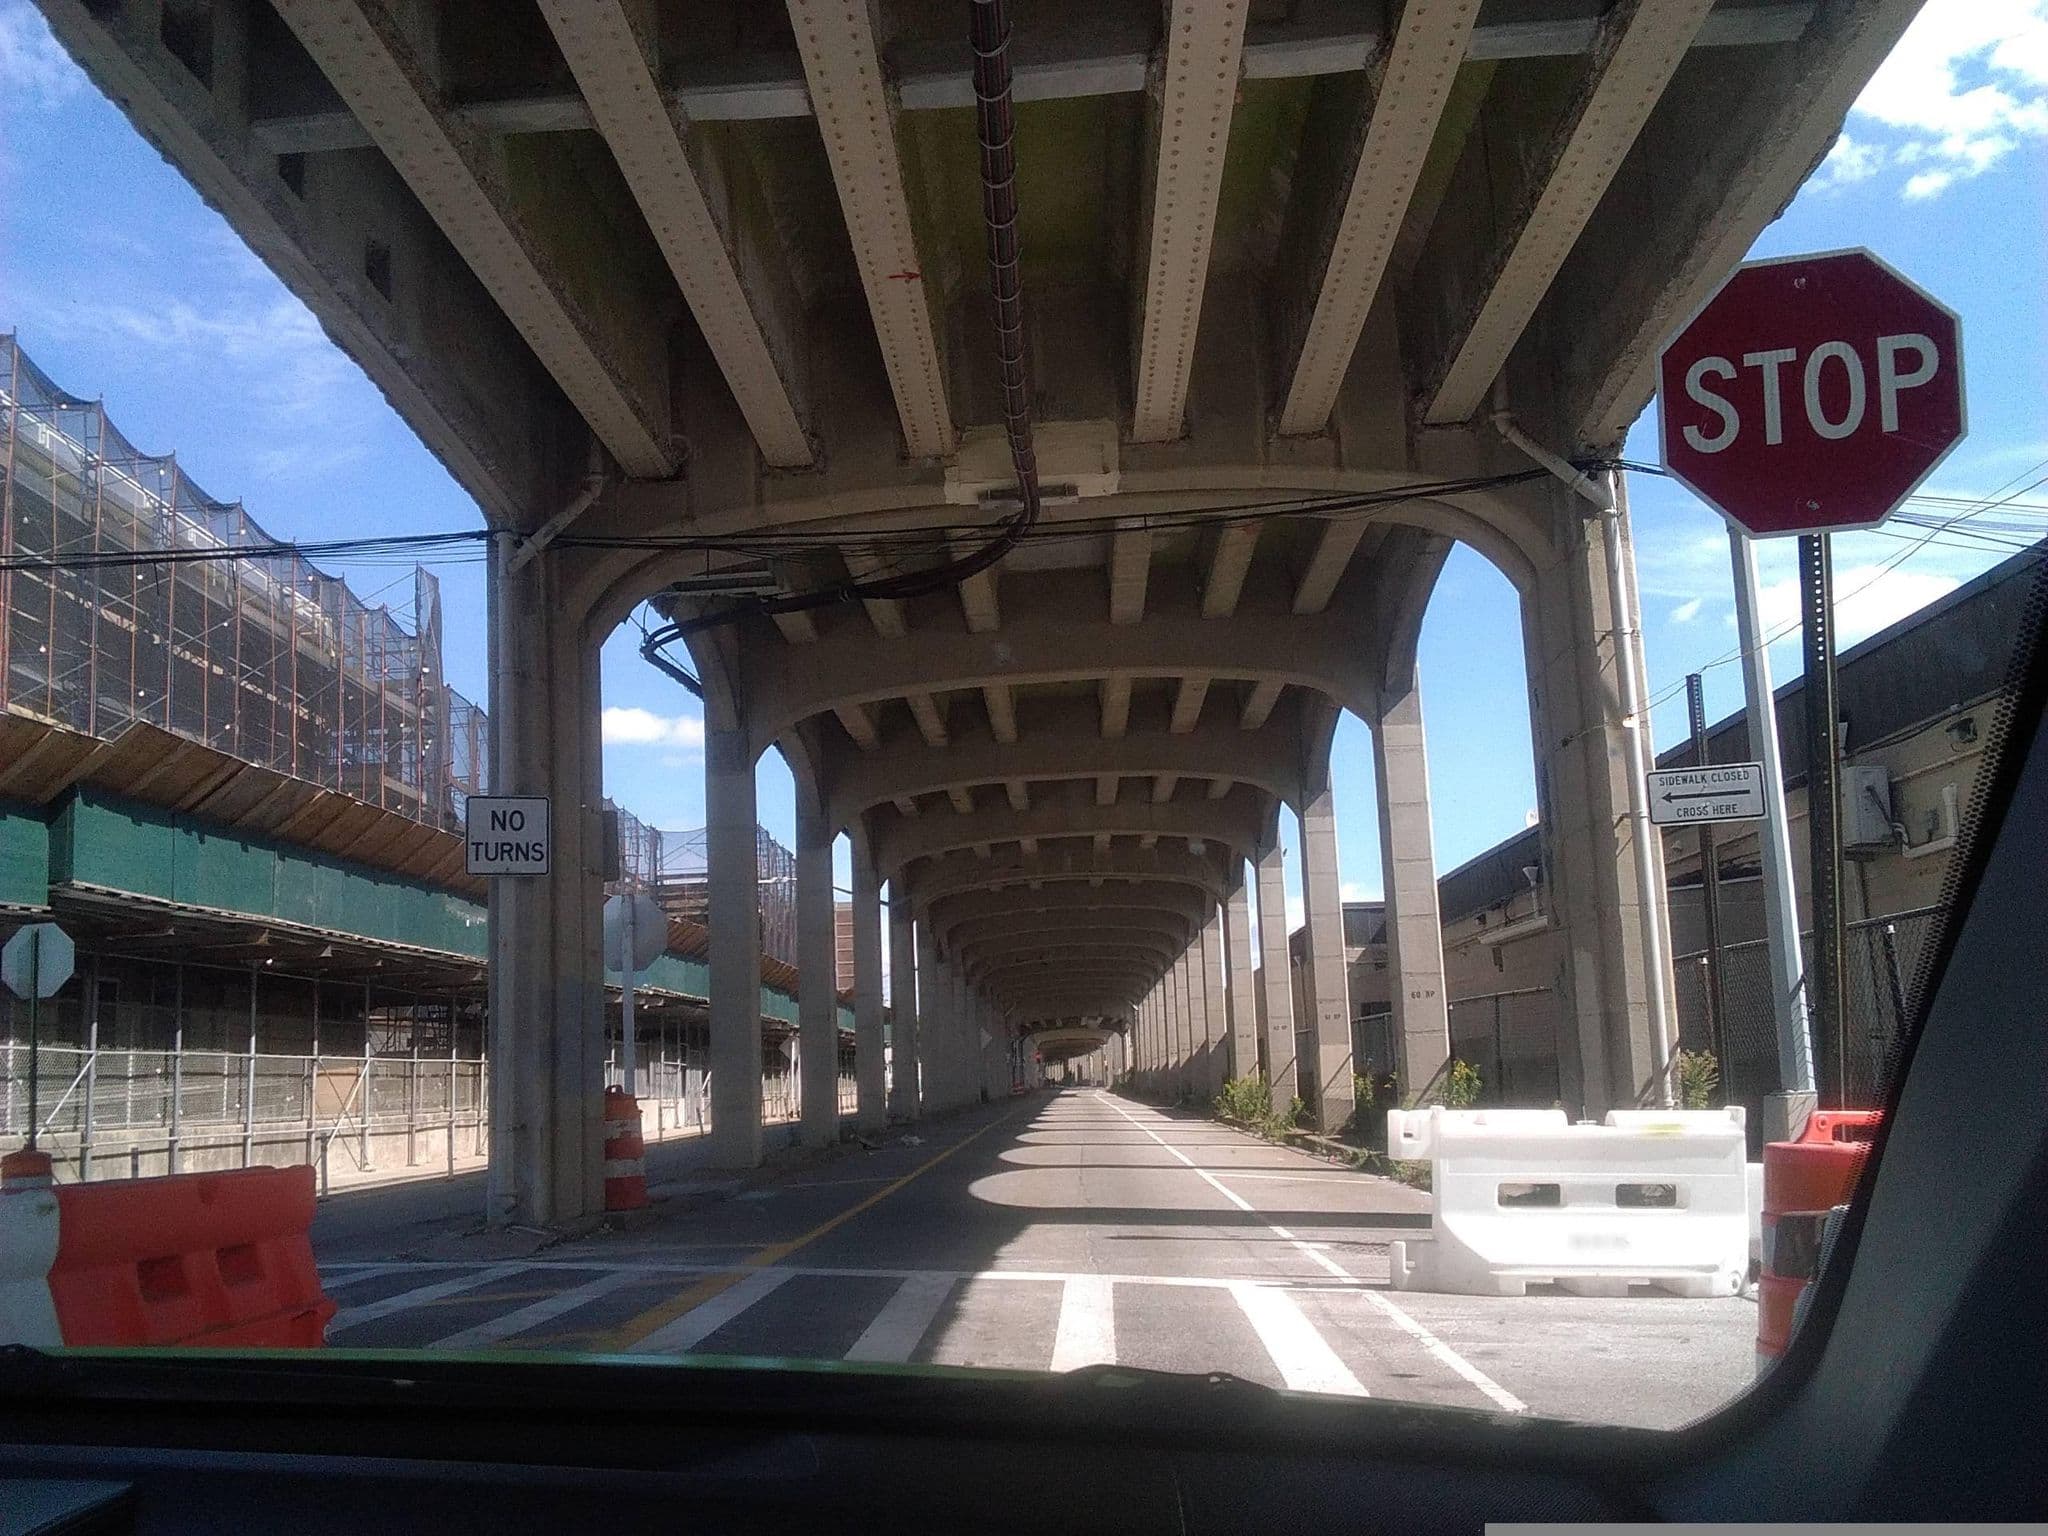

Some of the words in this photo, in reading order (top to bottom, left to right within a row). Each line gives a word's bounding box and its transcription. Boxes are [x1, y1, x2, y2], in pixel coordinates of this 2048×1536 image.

[1682, 333, 1939, 453] STOP
[1659, 774, 1708, 786] SIDEWALK
[1711, 770, 1750, 783] CLOSED
[490, 809, 526, 832] NO
[1676, 805, 1709, 818] CROSS
[1712, 803, 1739, 815] HERE
[470, 841, 545, 862] TURNS
